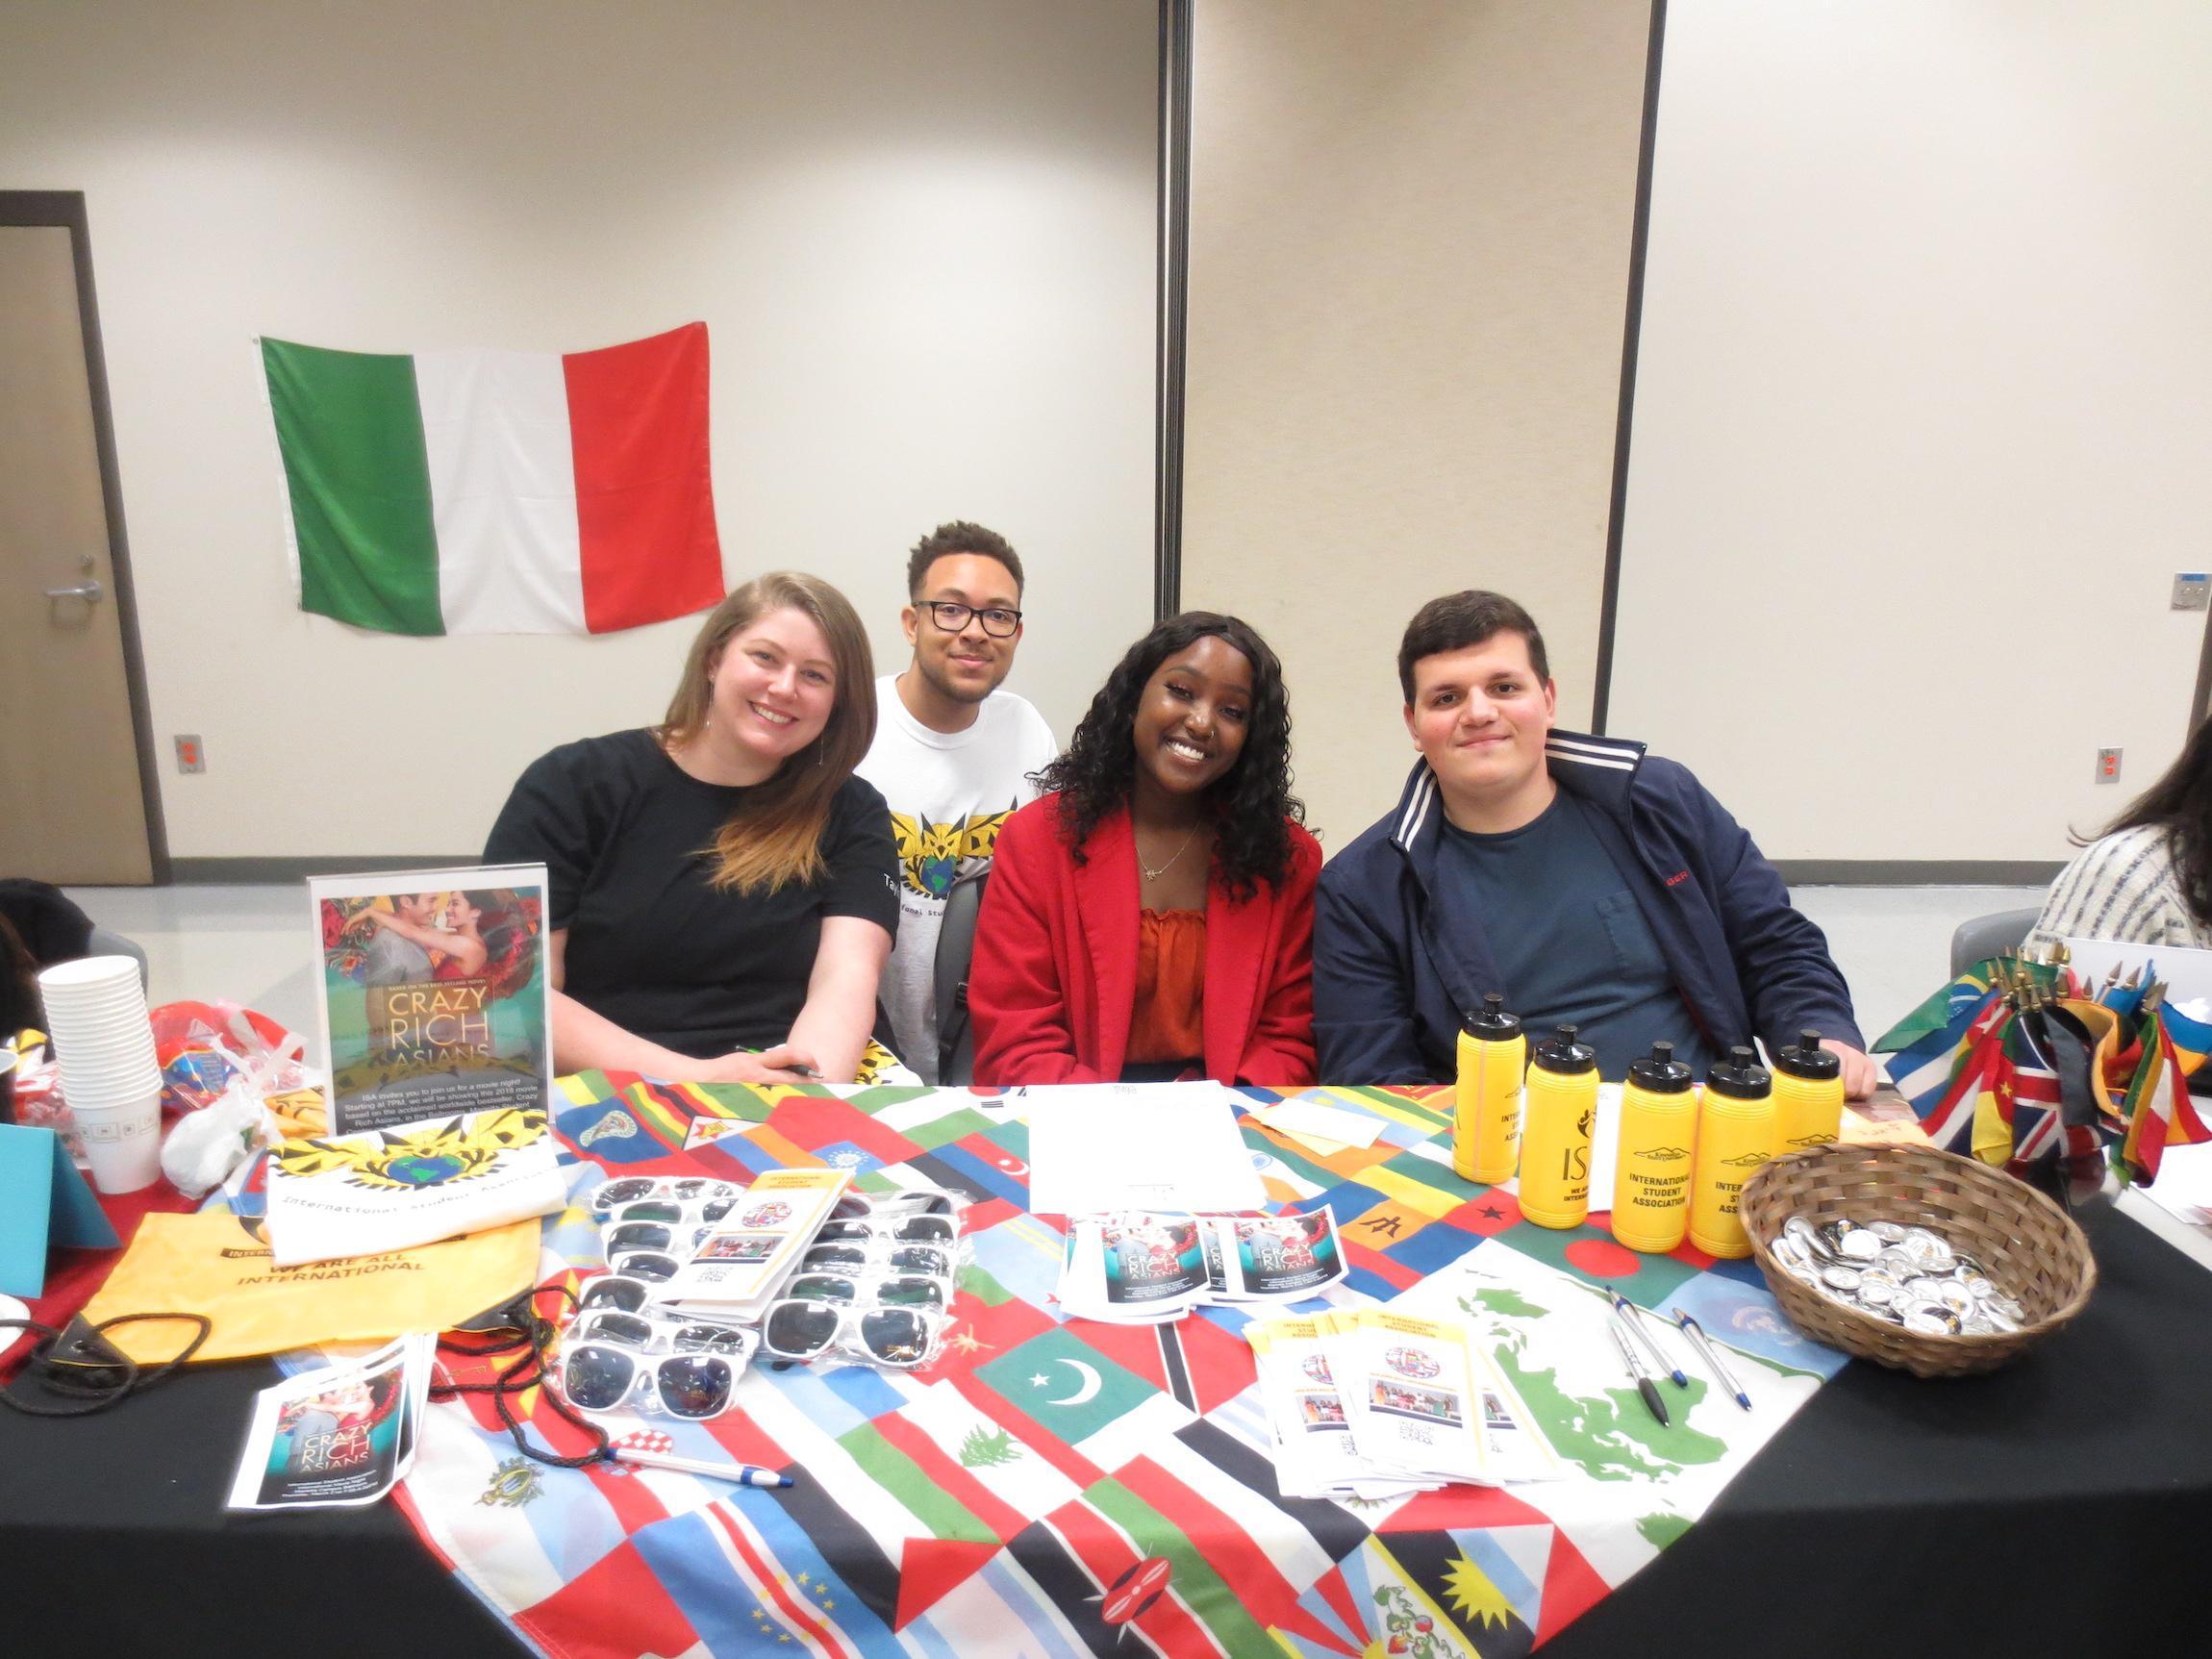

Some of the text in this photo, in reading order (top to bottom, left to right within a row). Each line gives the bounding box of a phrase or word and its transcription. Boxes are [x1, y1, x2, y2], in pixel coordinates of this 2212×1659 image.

[389, 986, 487, 1016] CRAZY
[390, 1011, 489, 1050] RICH
[396, 1044, 490, 1067] ASIANS
[345, 1103, 376, 1111] Starting
[448, 1092, 478, 1101] showing
[379, 1092, 404, 1100] invites
[430, 1086, 445, 1095] join
[345, 1111, 370, 1119] based
[516, 1093, 539, 1101] Crazy
[1563, 1146, 1590, 1181] IS
[1643, 1187, 1682, 1197] STUDENT
[1633, 1196, 1685, 1207] ASSOCIATION
[366, 1254, 406, 1263] ALL
[1128, 1251, 1178, 1264] CRAZY
[1261, 1243, 1310, 1256] CRAZY
[1262, 1249, 1314, 1267] RICH
[237, 1261, 426, 1285] INTERNATIONAL
[1128, 1258, 1180, 1274] RICH
[1131, 1268, 1181, 1280] ASIANS
[1266, 1260, 1315, 1271] ASIANS
[304, 1421, 374, 1448] CRAZY
[302, 1434, 370, 1464] RICH
[300, 1451, 369, 1473] ASIANS
